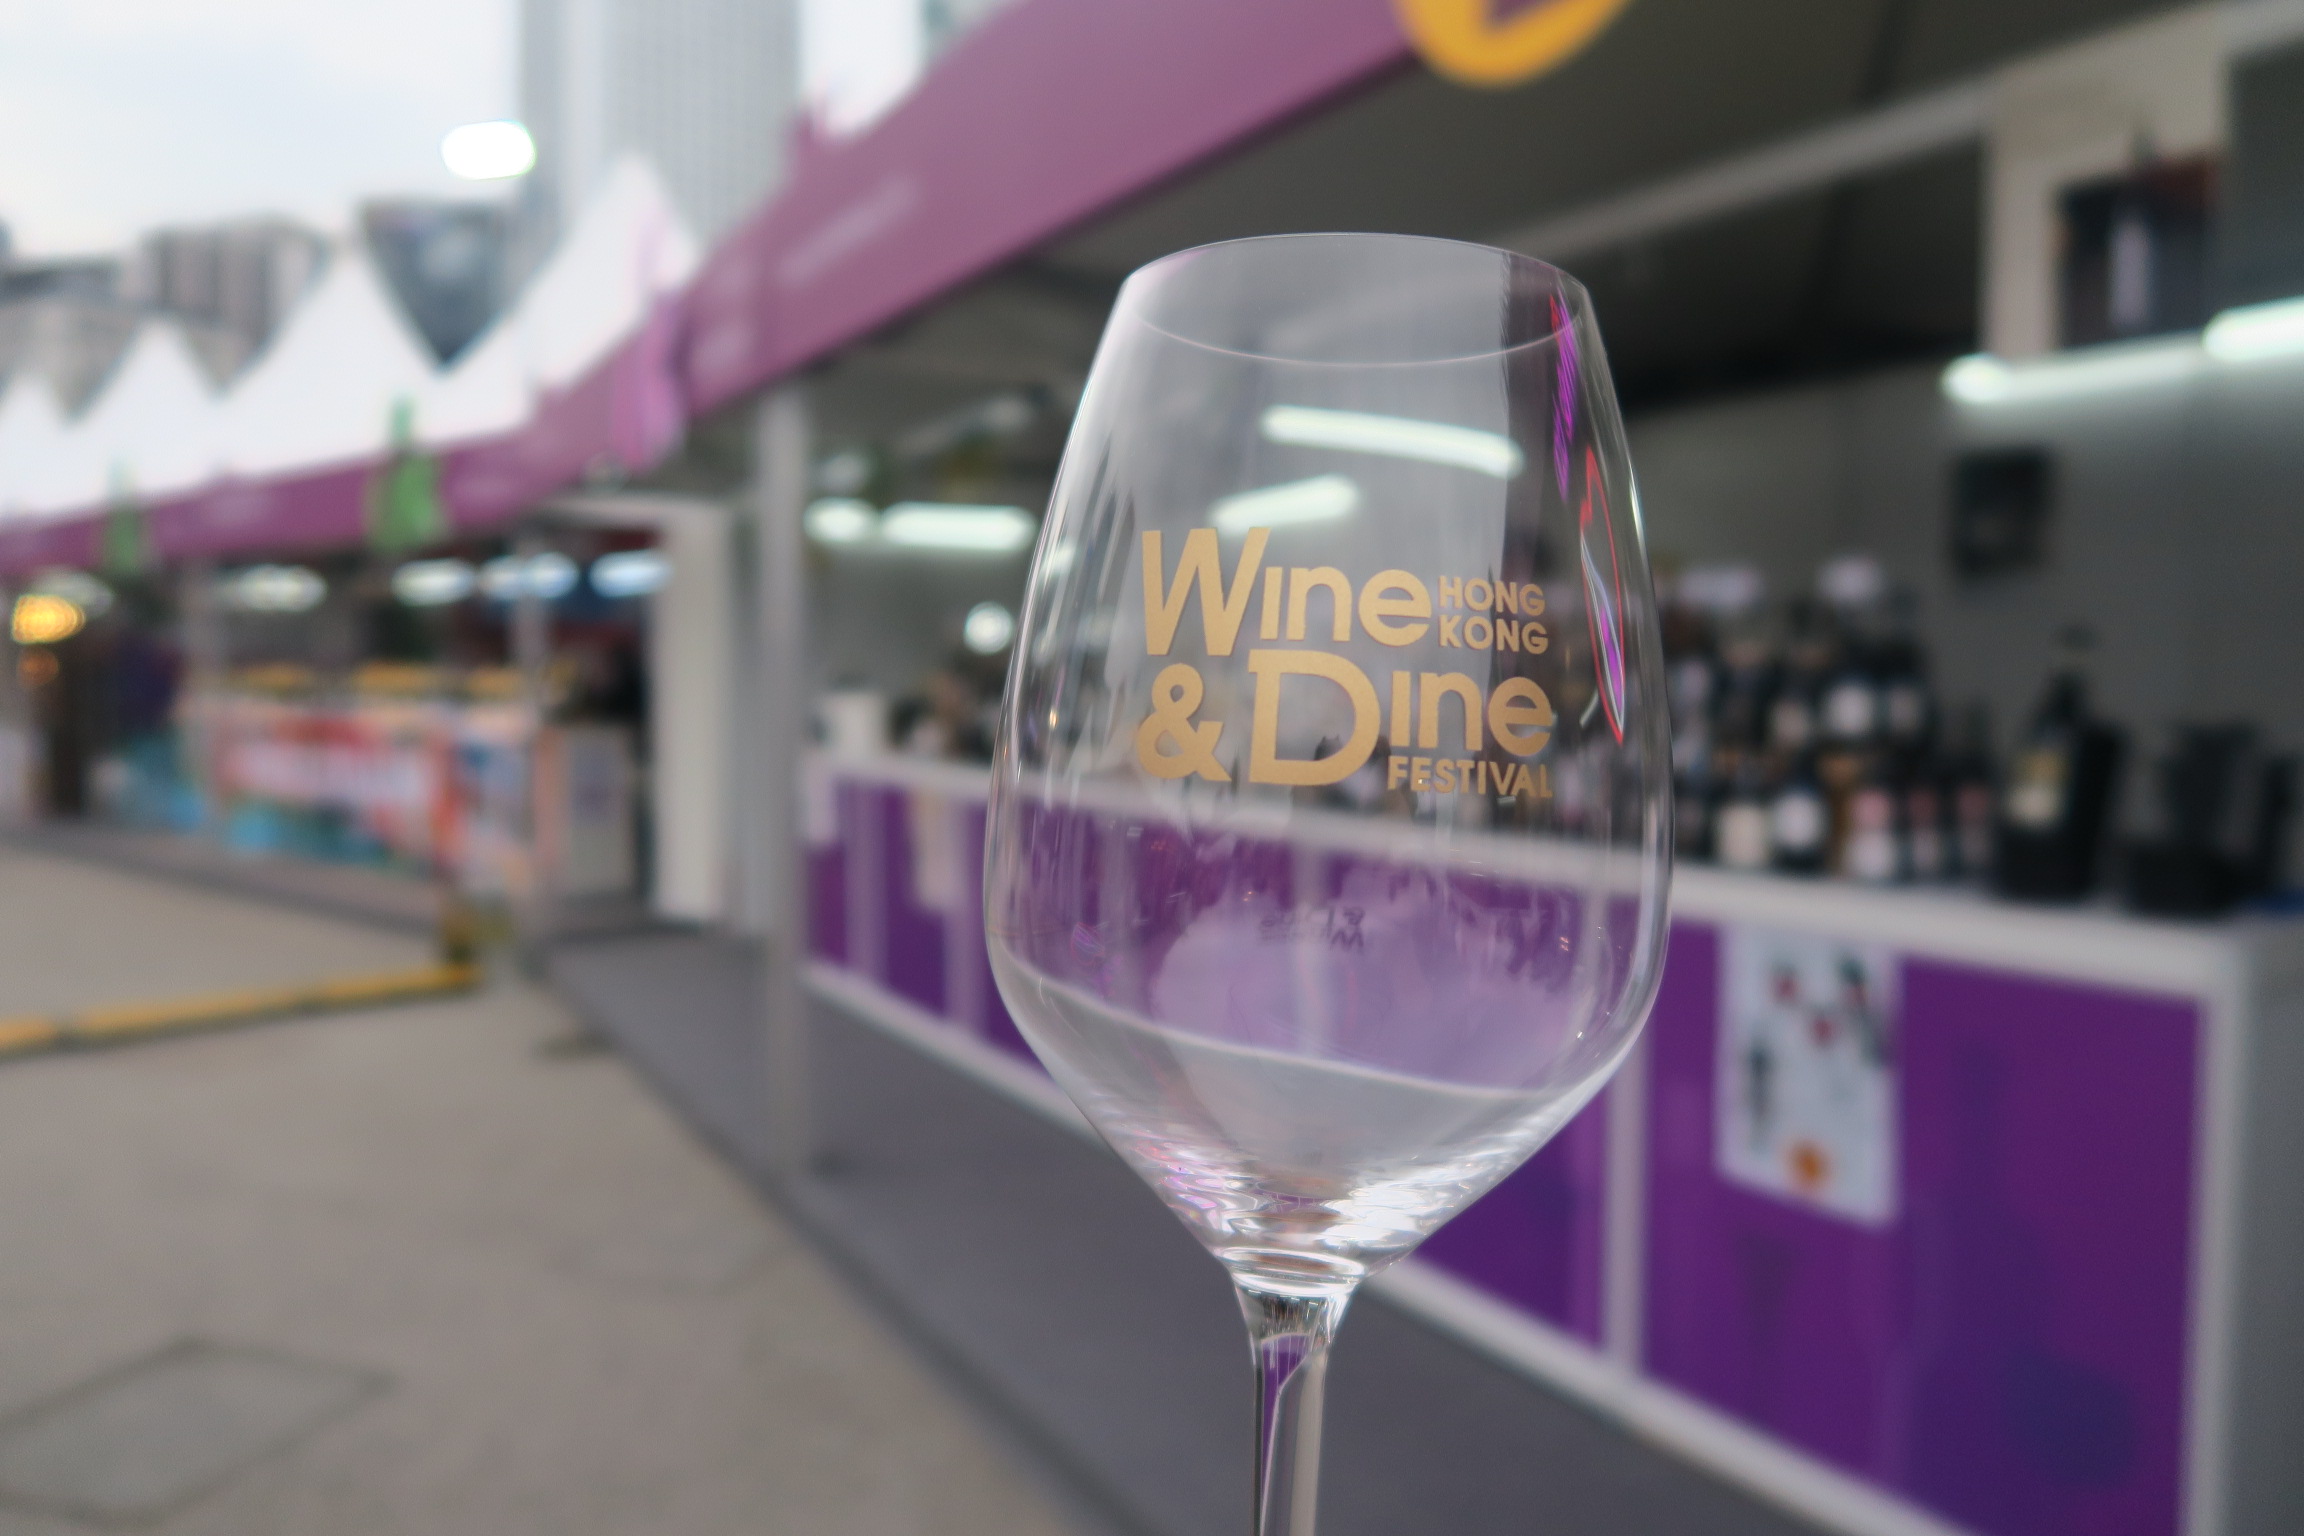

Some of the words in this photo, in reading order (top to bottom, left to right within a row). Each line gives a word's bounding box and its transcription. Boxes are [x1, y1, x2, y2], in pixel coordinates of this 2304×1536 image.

[1141, 527, 1432, 656] Wine
[1438, 576, 1546, 617] HONG
[1438, 615, 1549, 655] KONG
[1136, 663, 1232, 781] &
[1248, 648, 1553, 786] Dine
[1387, 755, 1553, 799] FESTIVAL
